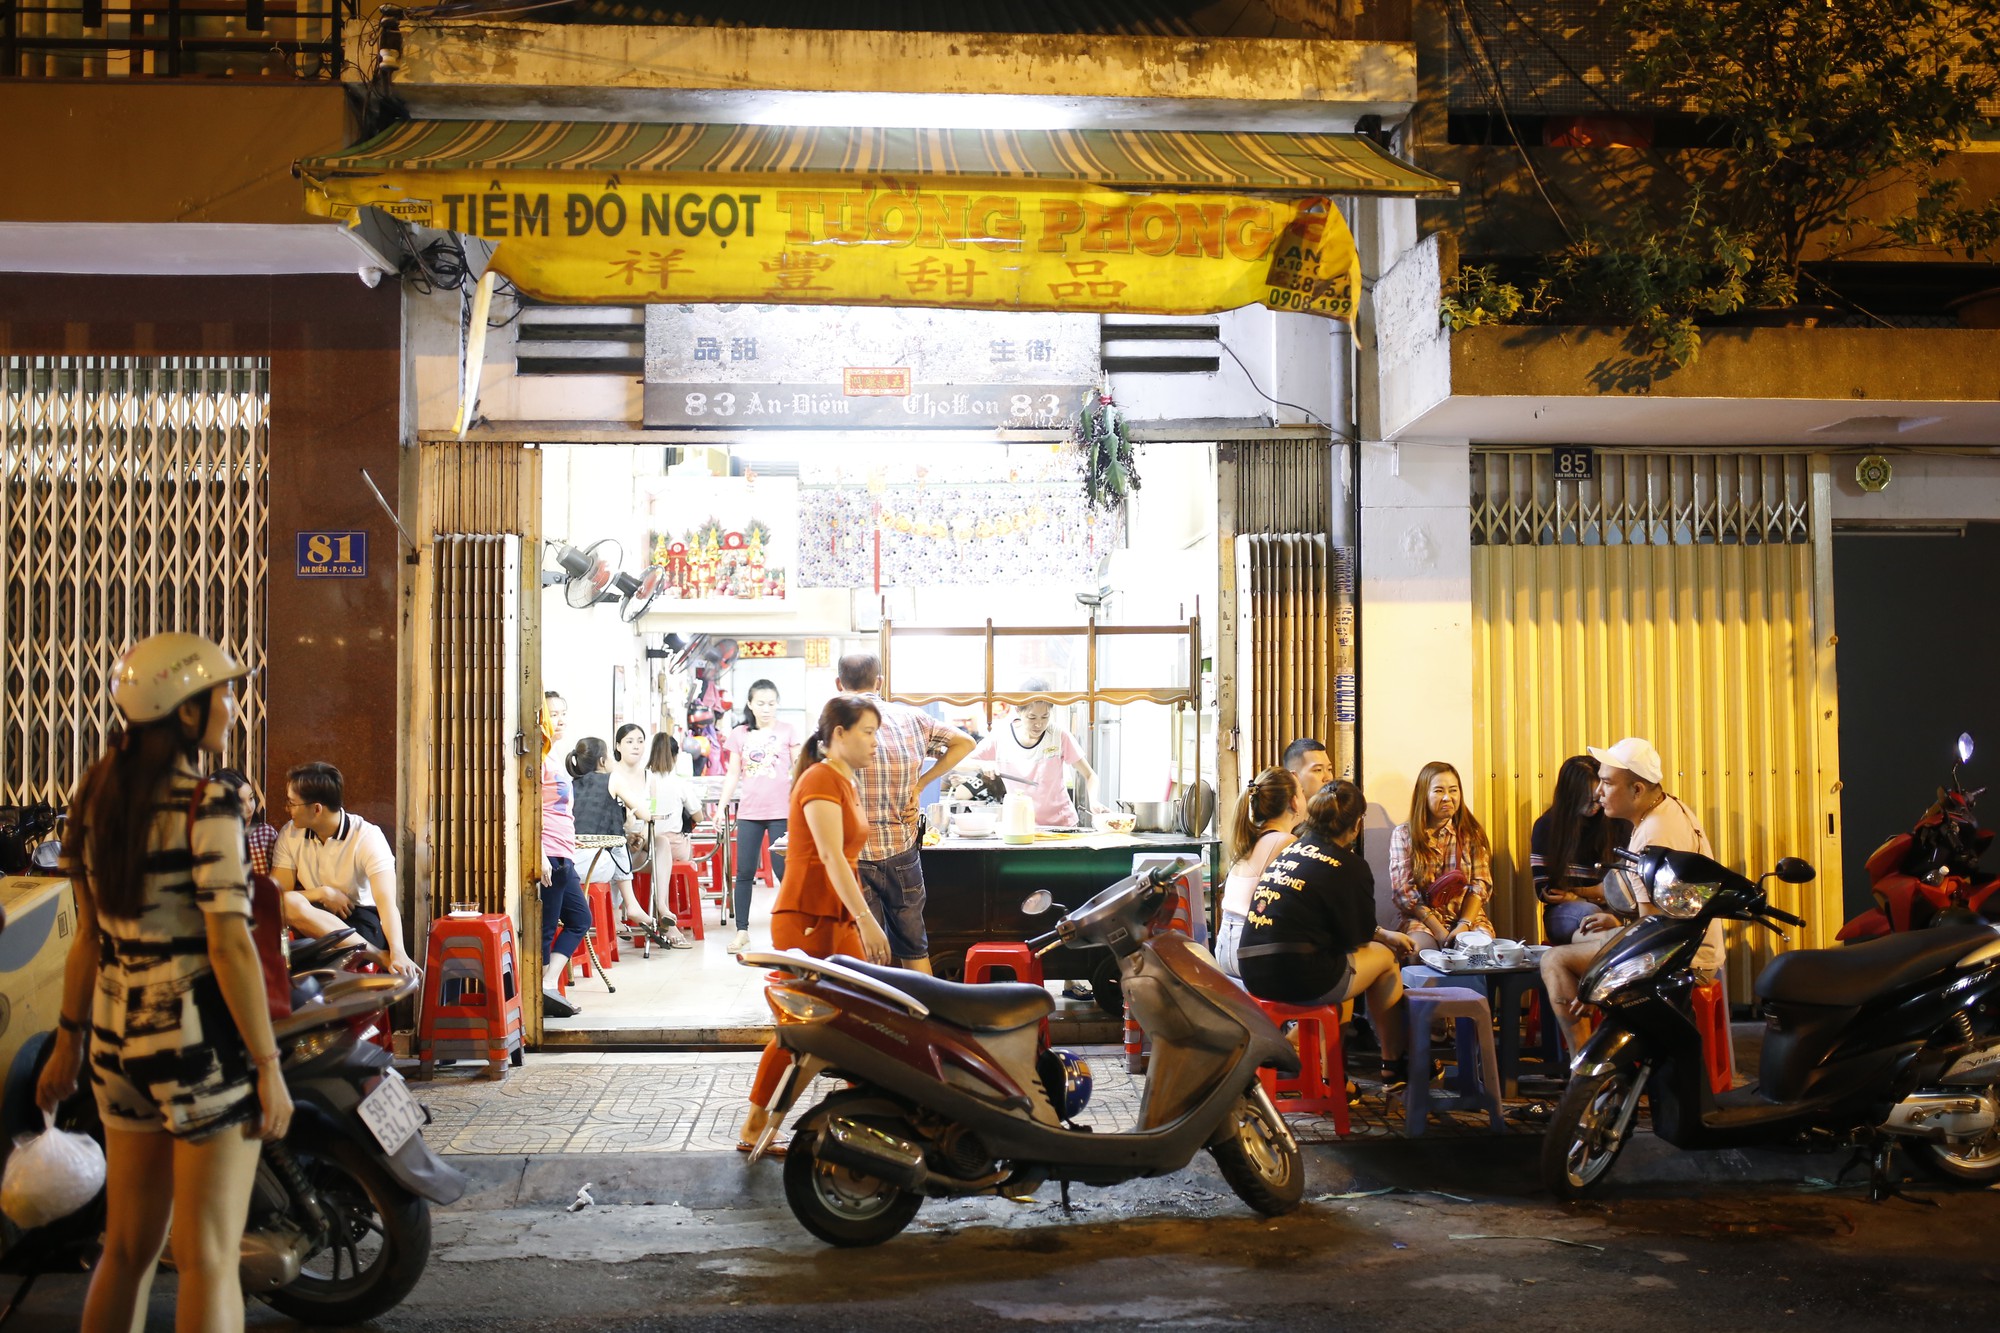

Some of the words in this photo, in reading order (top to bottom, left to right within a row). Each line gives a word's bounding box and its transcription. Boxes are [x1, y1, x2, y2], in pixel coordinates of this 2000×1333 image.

[564, 173, 627, 237] ĐỒ
[641, 192, 762, 250] NGỌT
[777, 176, 1026, 253] TƯỜNG
[1037, 196, 1277, 264] PHONG
[684, 392, 736, 417] 83
[1010, 393, 1061, 419] 83
[1559, 453, 1588, 474] 85
[306, 534, 356, 564] 81
[1621, 996, 1651, 1009] HONDA
